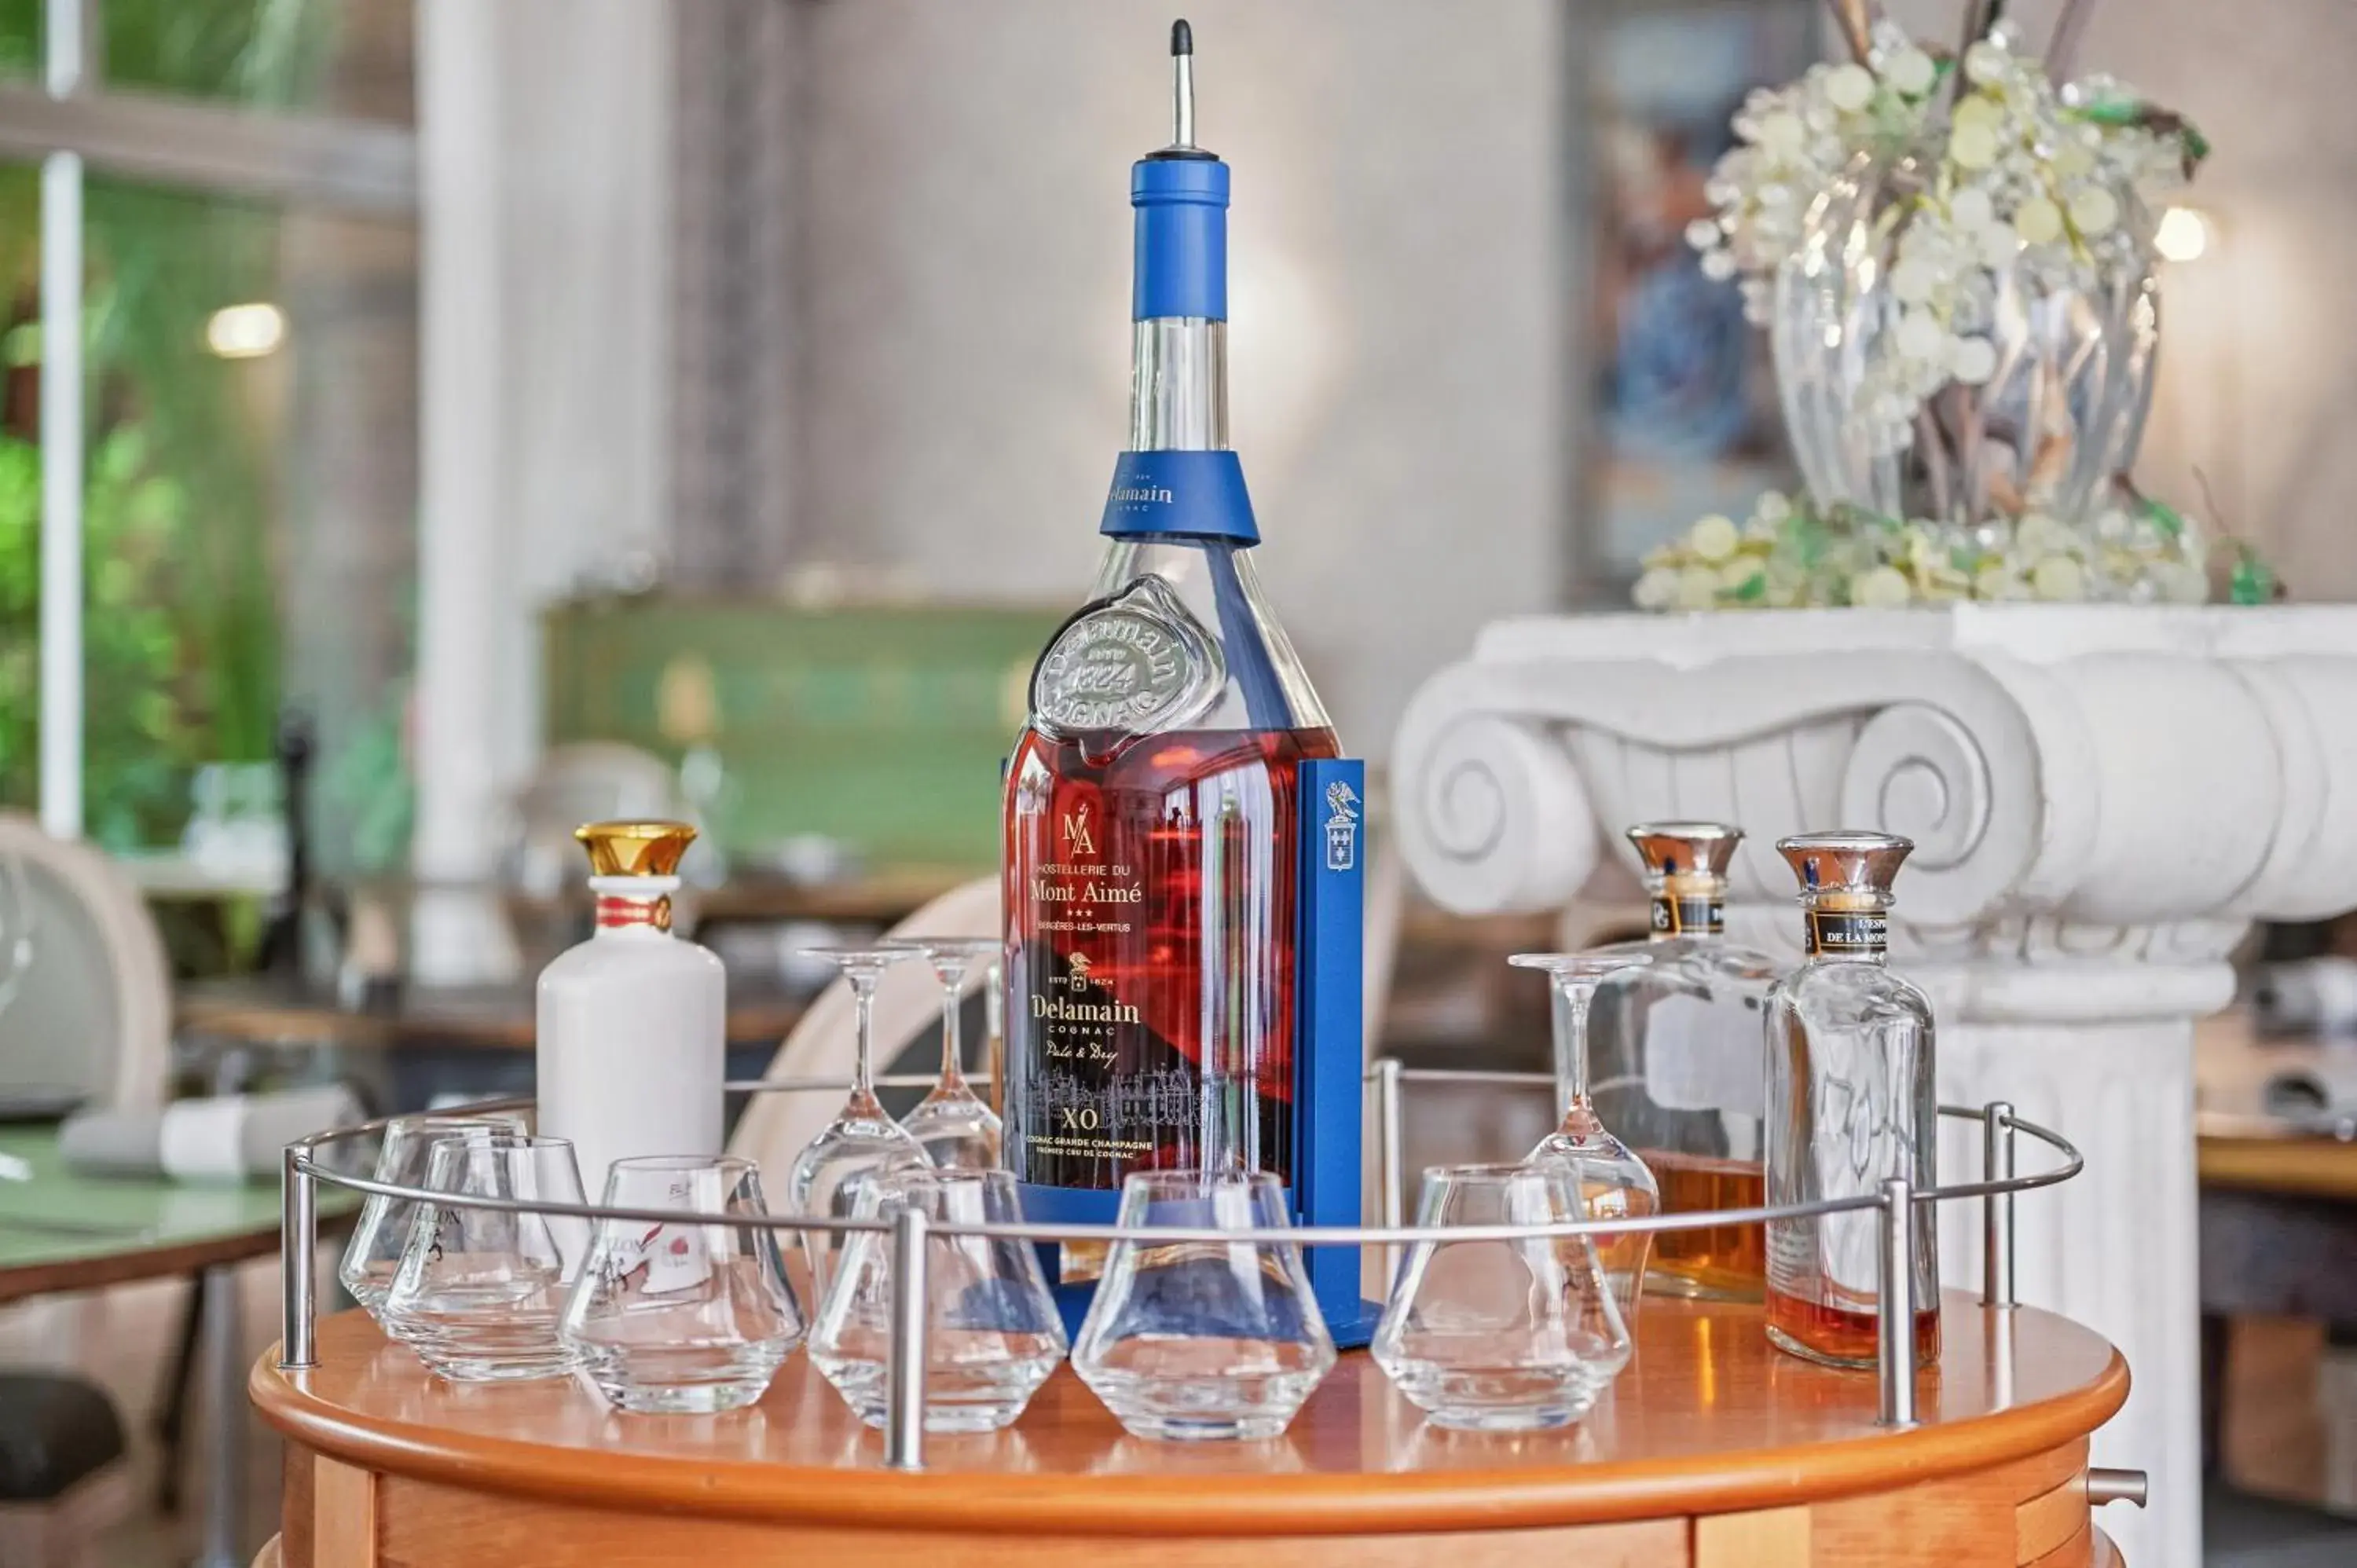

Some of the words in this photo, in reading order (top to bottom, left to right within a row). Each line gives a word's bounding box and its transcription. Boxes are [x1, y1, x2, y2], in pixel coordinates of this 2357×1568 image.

[1113, 865, 1131, 876] DU
[1031, 879, 1076, 901] Mont
[1081, 881, 1142, 903] Aimé
[1827, 932, 1844, 942] DE
[1846, 932, 1862, 943] LA
[1032, 995, 1142, 1024] Delamain
[1048, 1025, 1116, 1036] COGNAC
[1076, 1047, 1086, 1059] &
[1090, 1042, 1119, 1069] Dry
[1062, 1108, 1099, 1130] XO
[1054, 1137, 1090, 1147] GRANDE
[1091, 1138, 1153, 1150] CHAMPAGNE
[1066, 1148, 1082, 1156] CRU
[1098, 1150, 1135, 1159] COGNAC
